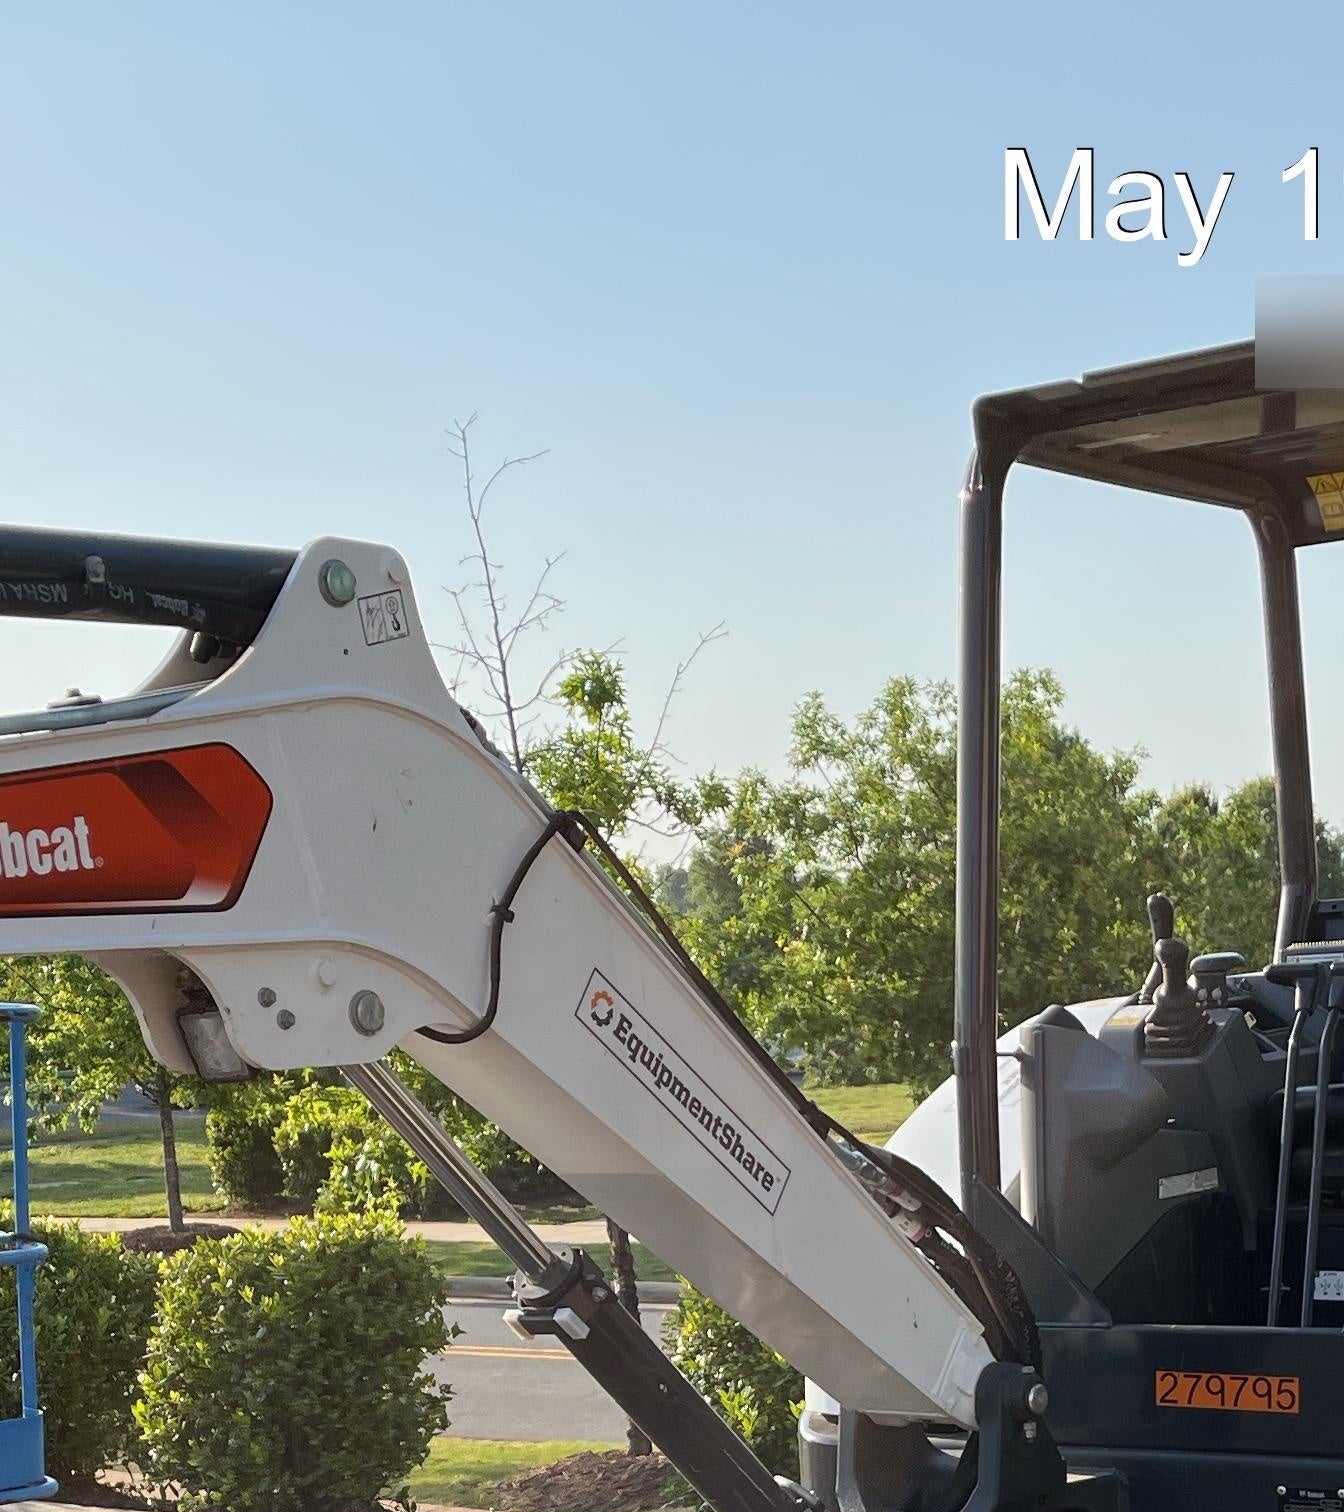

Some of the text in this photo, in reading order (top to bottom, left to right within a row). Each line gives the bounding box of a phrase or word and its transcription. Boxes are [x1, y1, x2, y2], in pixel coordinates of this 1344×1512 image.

[9, 582, 68, 603] MSHA
[612, 1013, 775, 1193] EquipmentShare
[1159, 1372, 1296, 1410] 279795
